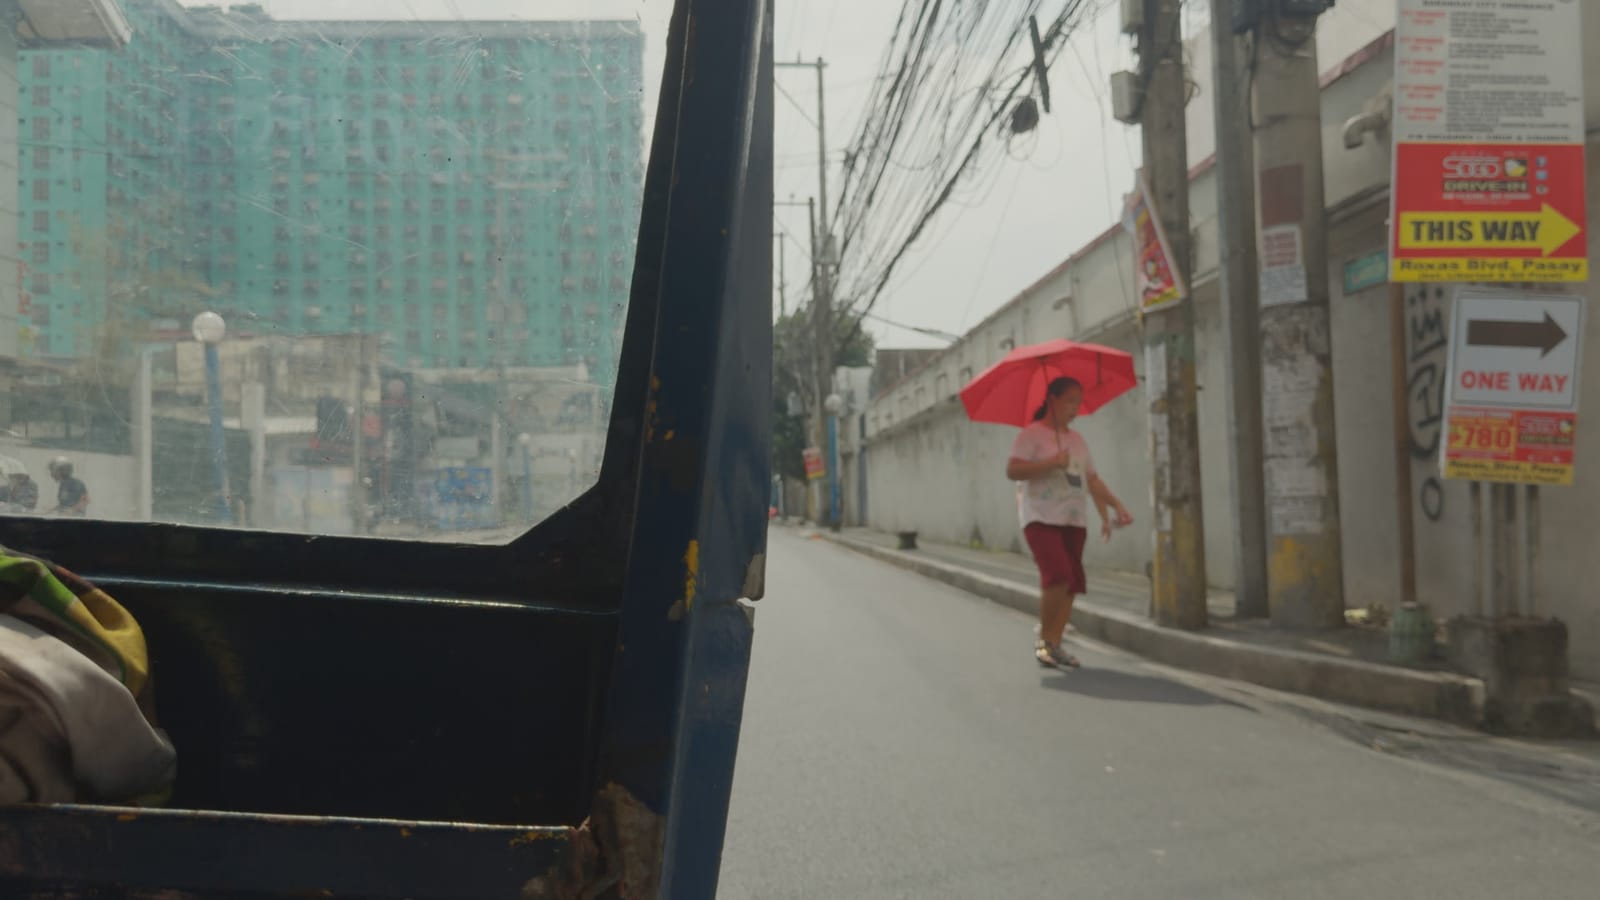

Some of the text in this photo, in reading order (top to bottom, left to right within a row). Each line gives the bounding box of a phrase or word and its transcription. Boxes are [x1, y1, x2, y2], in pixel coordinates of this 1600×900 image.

[1410, 220, 1541, 242] THIS WAY
[1400, 259, 1460, 270] Roxas
[1523, 259, 1582, 272] Pasay
[1460, 370, 1568, 393] ONE WAY
